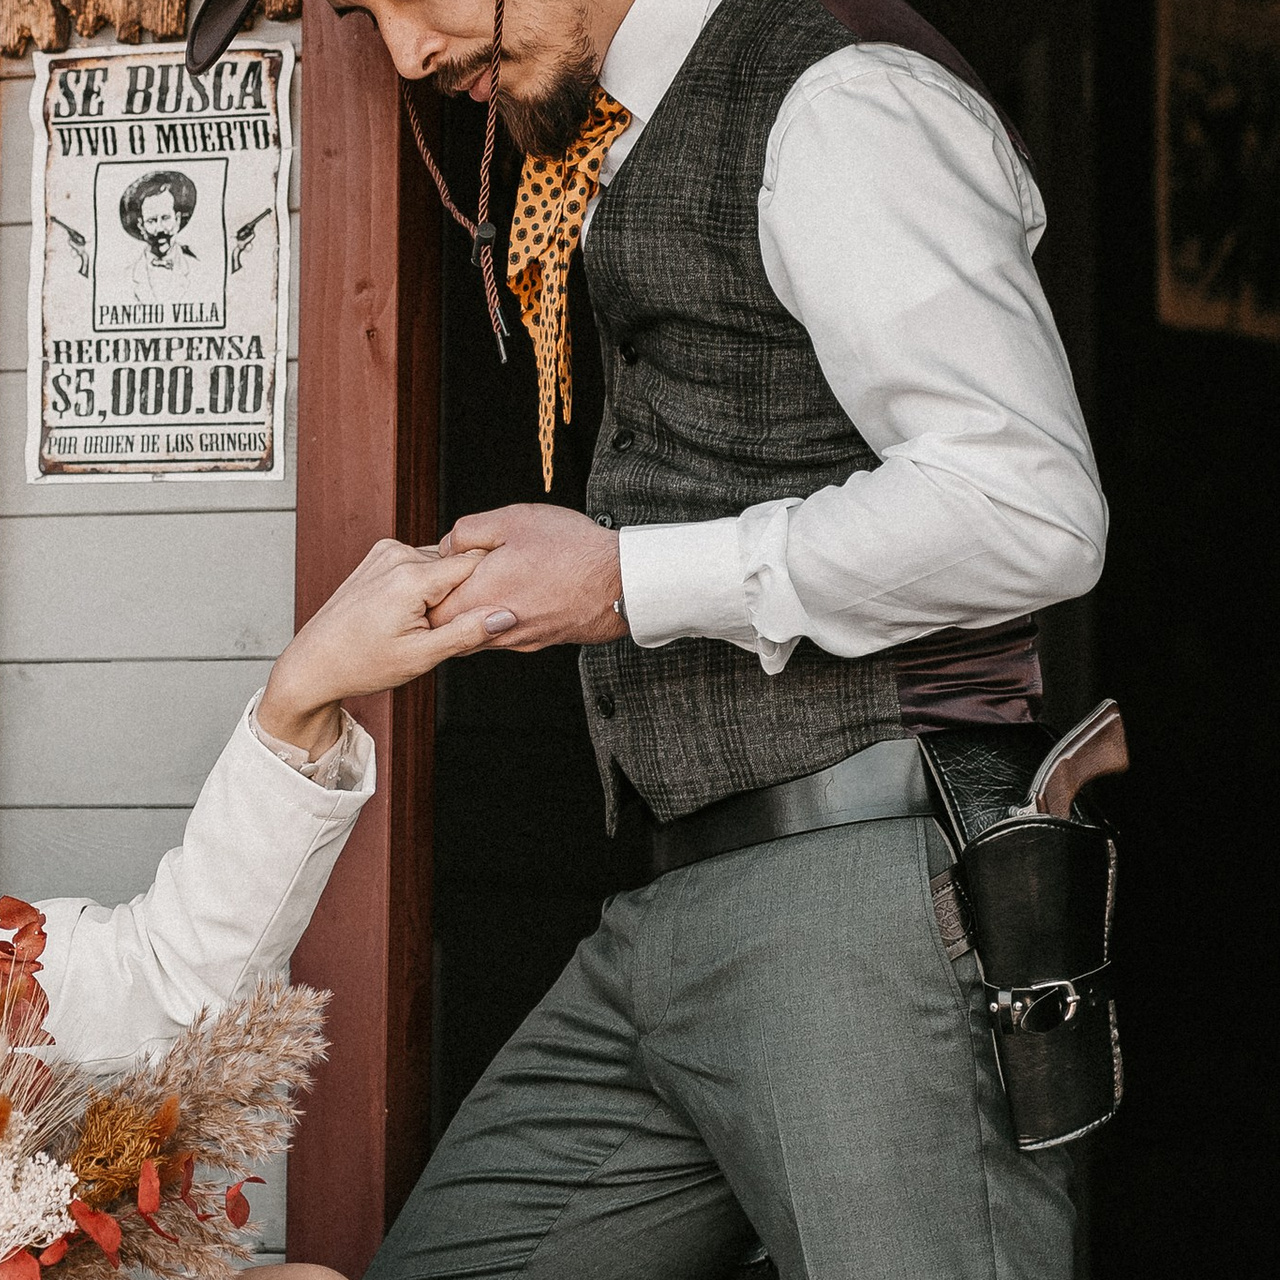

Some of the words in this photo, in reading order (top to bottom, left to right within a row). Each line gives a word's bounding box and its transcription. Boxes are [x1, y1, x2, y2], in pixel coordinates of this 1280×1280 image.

[54, 68, 108, 118] SE
[122, 61, 267, 115] BUSCA
[56, 125, 117, 157] VIVO
[129, 124, 146, 155] O
[155, 119, 270, 154] MUERTO
[99, 303, 164, 326] PANCHO
[172, 301, 220, 324] VILLA
[52, 335, 266, 364] RECOMPENSA
[52, 364, 264, 422] $5,000.00
[47, 436, 78, 455] POR
[84, 434, 135, 455] ORDEN
[140, 433, 161, 453] DE
[166, 432, 194, 453] LOS
[199, 431, 267, 452] GRINGOS
